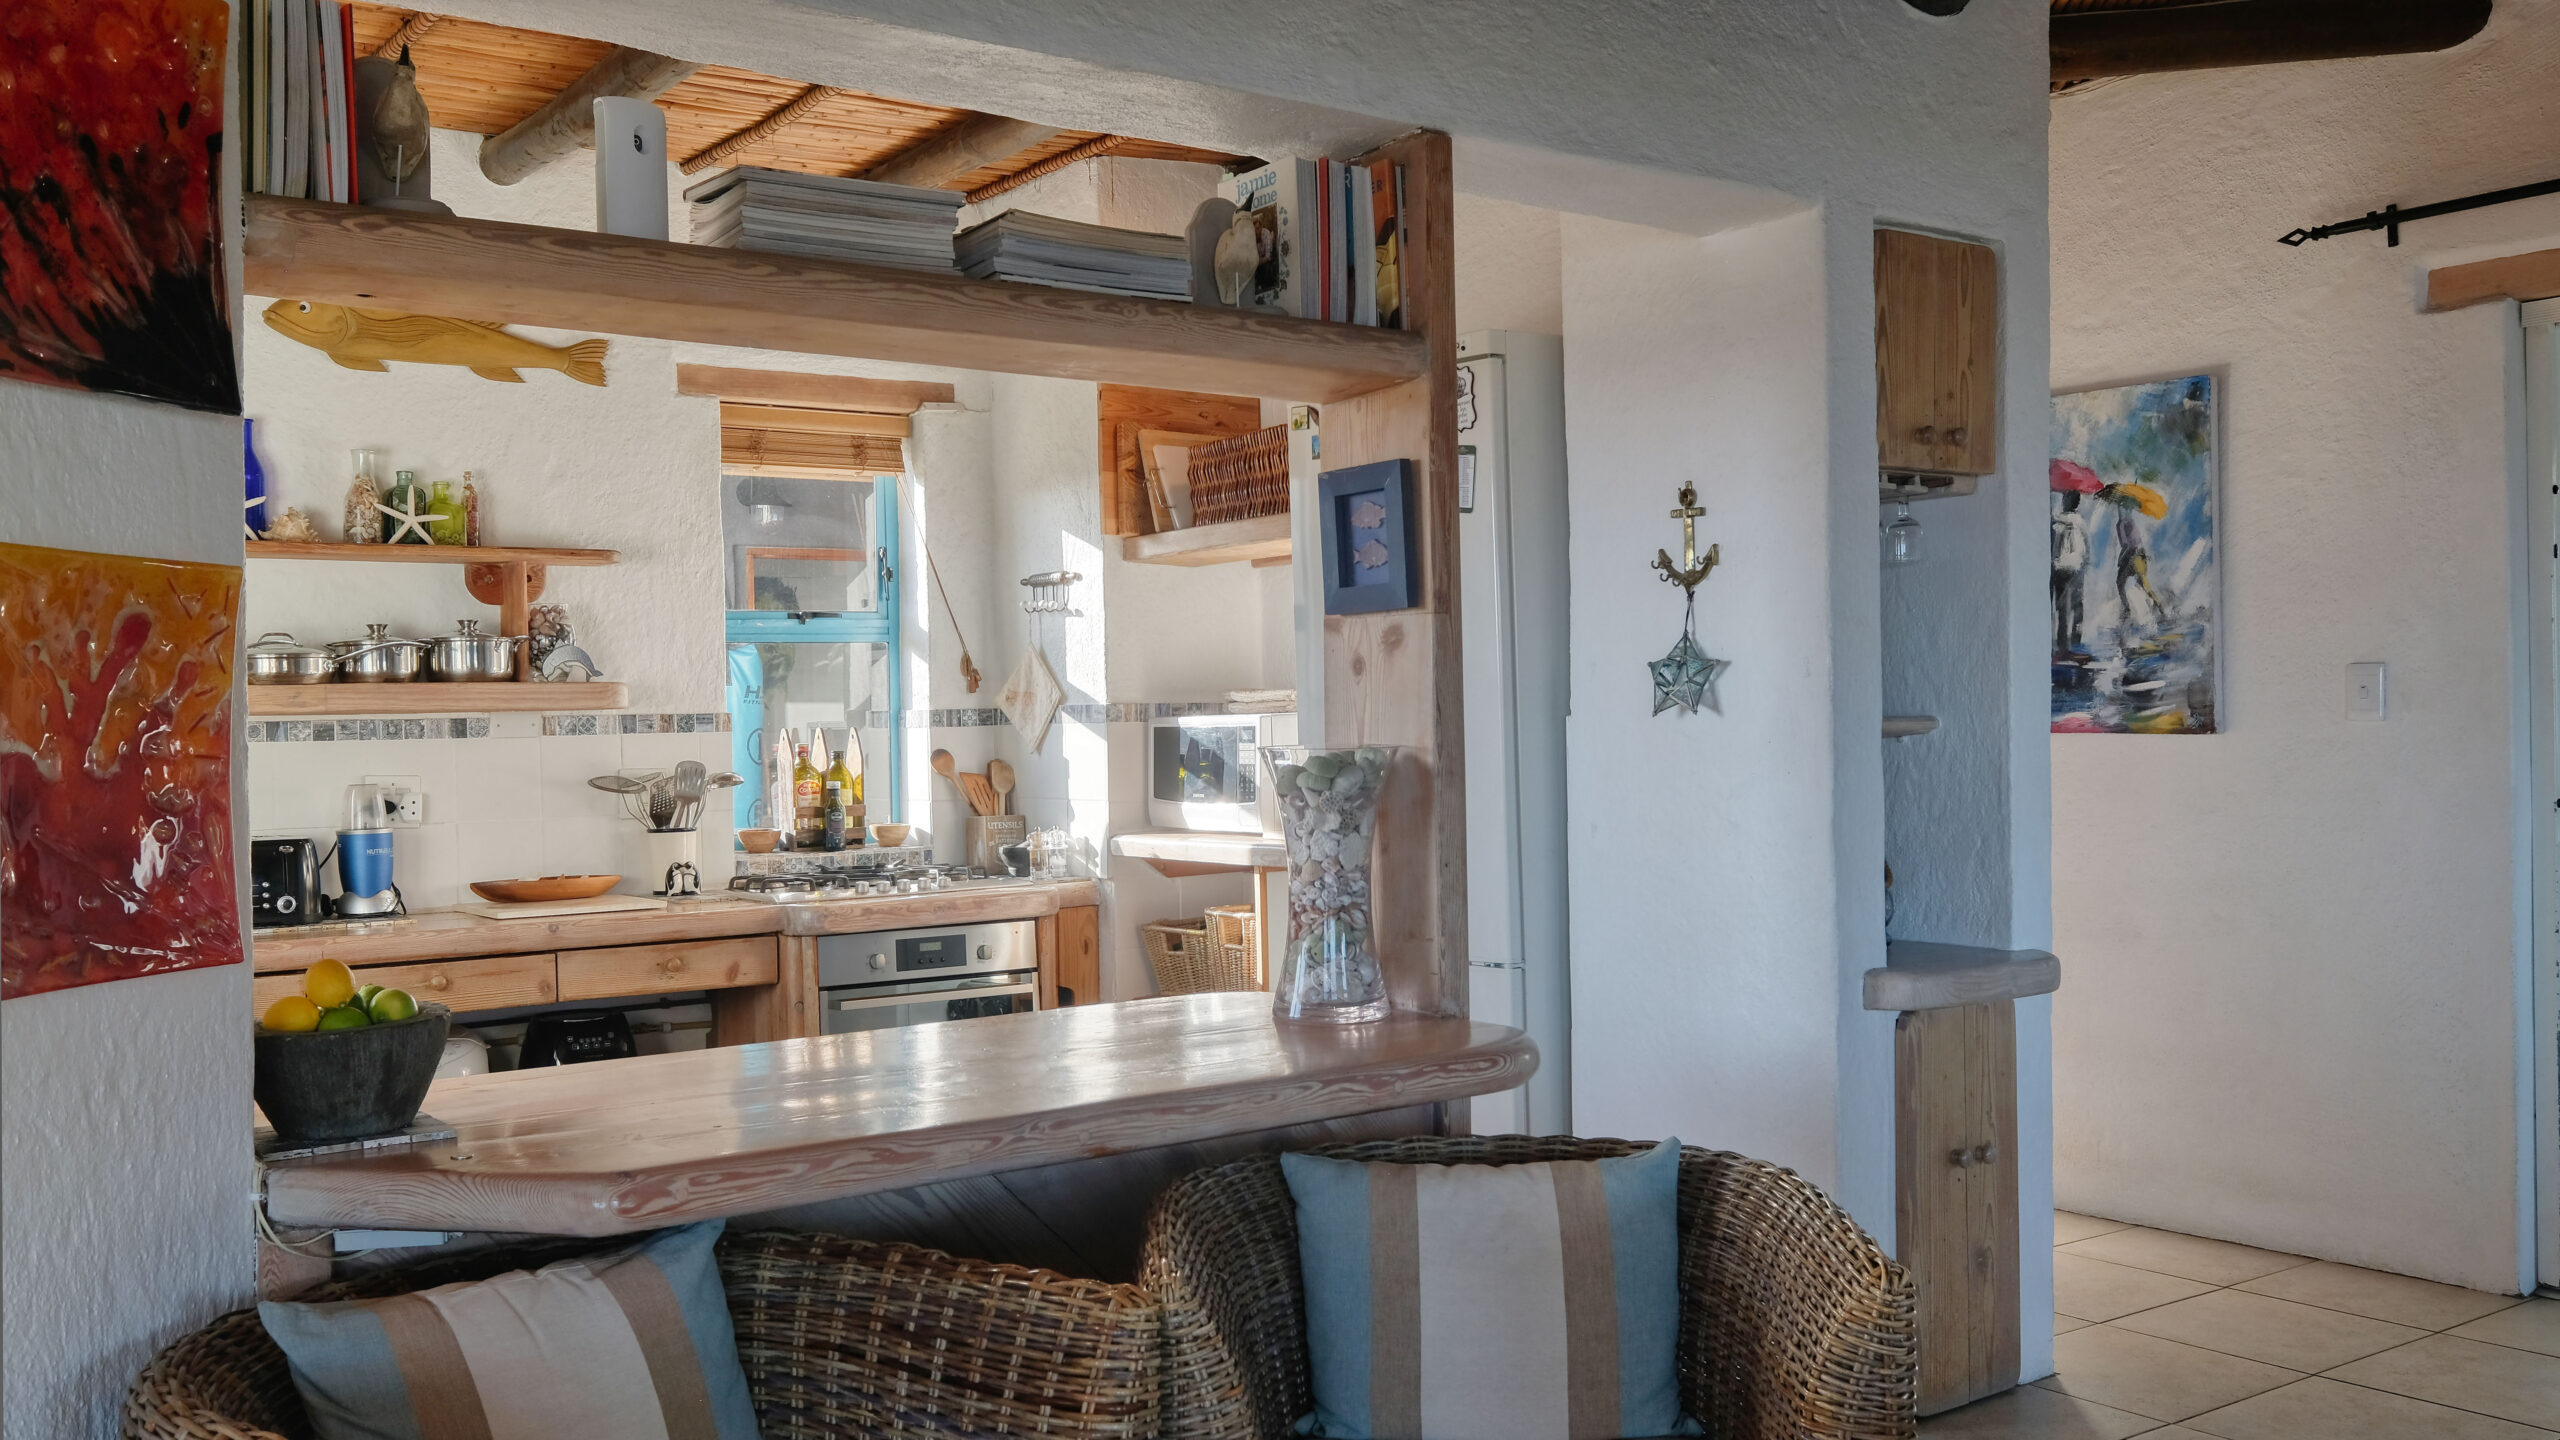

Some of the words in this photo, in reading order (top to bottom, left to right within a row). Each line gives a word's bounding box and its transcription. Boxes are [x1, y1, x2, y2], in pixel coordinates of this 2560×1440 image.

[1236, 168, 1277, 204] jamie
[1250, 190, 1278, 209] ome
[987, 821, 1024, 830] UTENSILS
